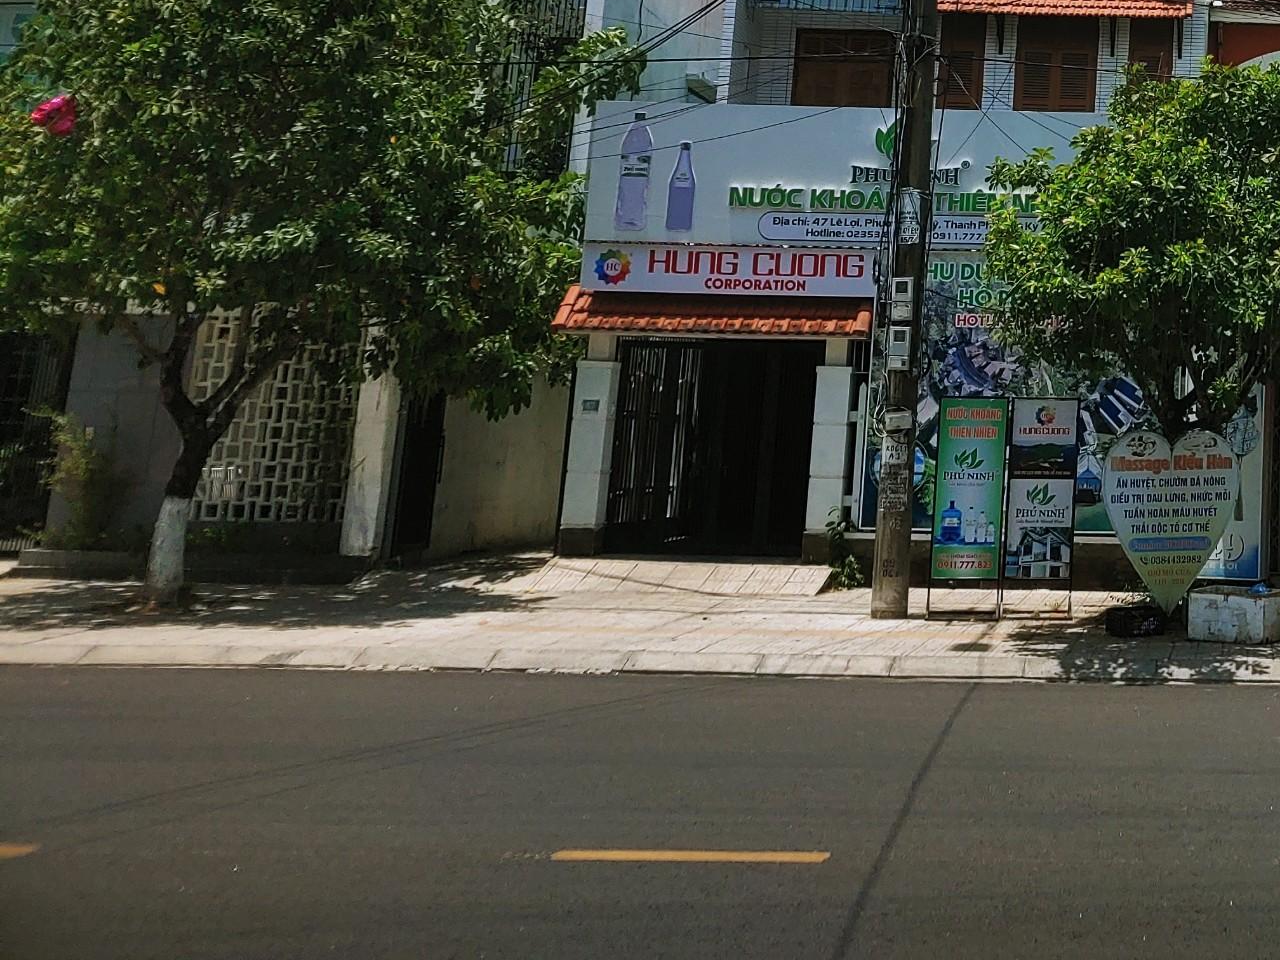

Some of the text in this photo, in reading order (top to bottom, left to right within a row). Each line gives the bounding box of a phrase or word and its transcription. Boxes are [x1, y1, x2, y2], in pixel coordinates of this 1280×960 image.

[729, 183, 804, 208] NƯỚC
[812, 217, 829, 227] 47
[830, 217, 843, 227] Lê
[805, 228, 845, 238] Hotline:
[605, 261, 620, 272] HC
[704, 277, 806, 291] CORPORATION
[943, 469, 995, 482] PHÚ NINH
[1015, 505, 1065, 519] PHÚ NINH
